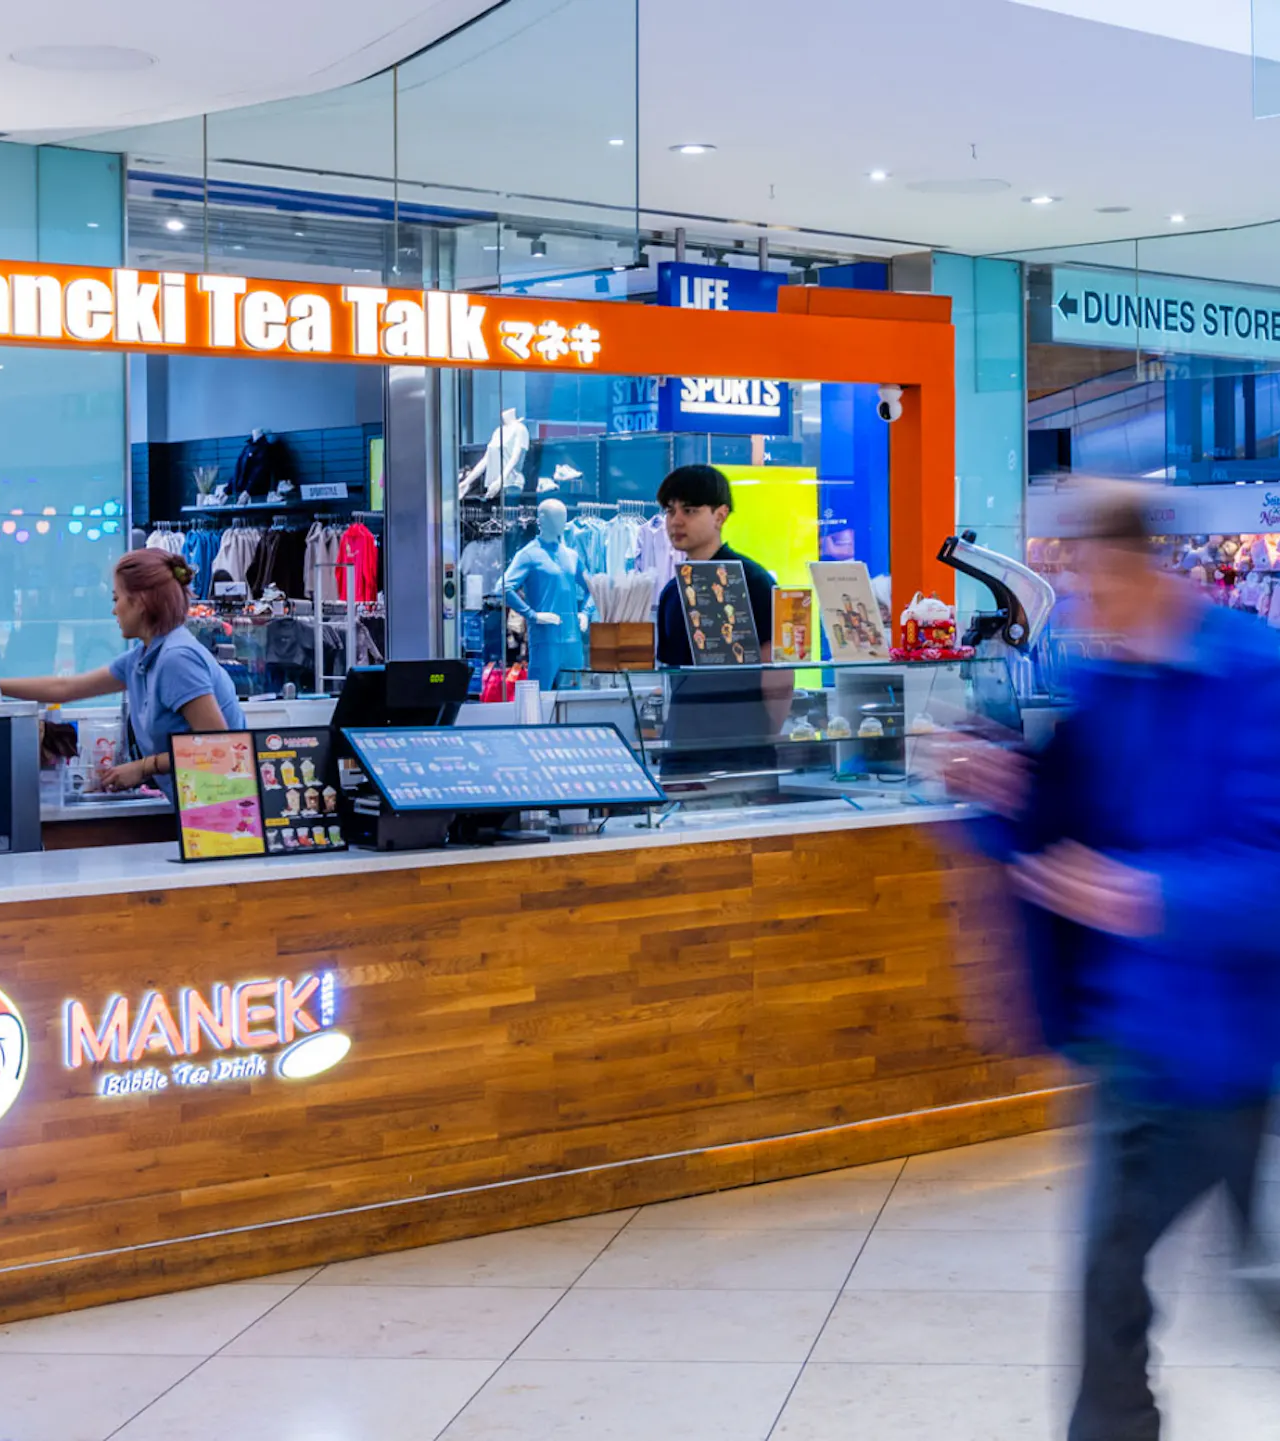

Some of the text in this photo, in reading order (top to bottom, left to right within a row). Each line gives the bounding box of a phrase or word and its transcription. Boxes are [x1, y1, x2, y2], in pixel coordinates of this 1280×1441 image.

[680, 275, 729, 311] LIFE
[1083, 290, 1196, 334] DUNNES
[197, 274, 332, 353] Tea
[342, 285, 489, 362] Talk
[499, 319, 601, 364] マネキ
[680, 377, 781, 406] SPORTS
[103, 1054, 267, 1096] Bubble Tea Drink
